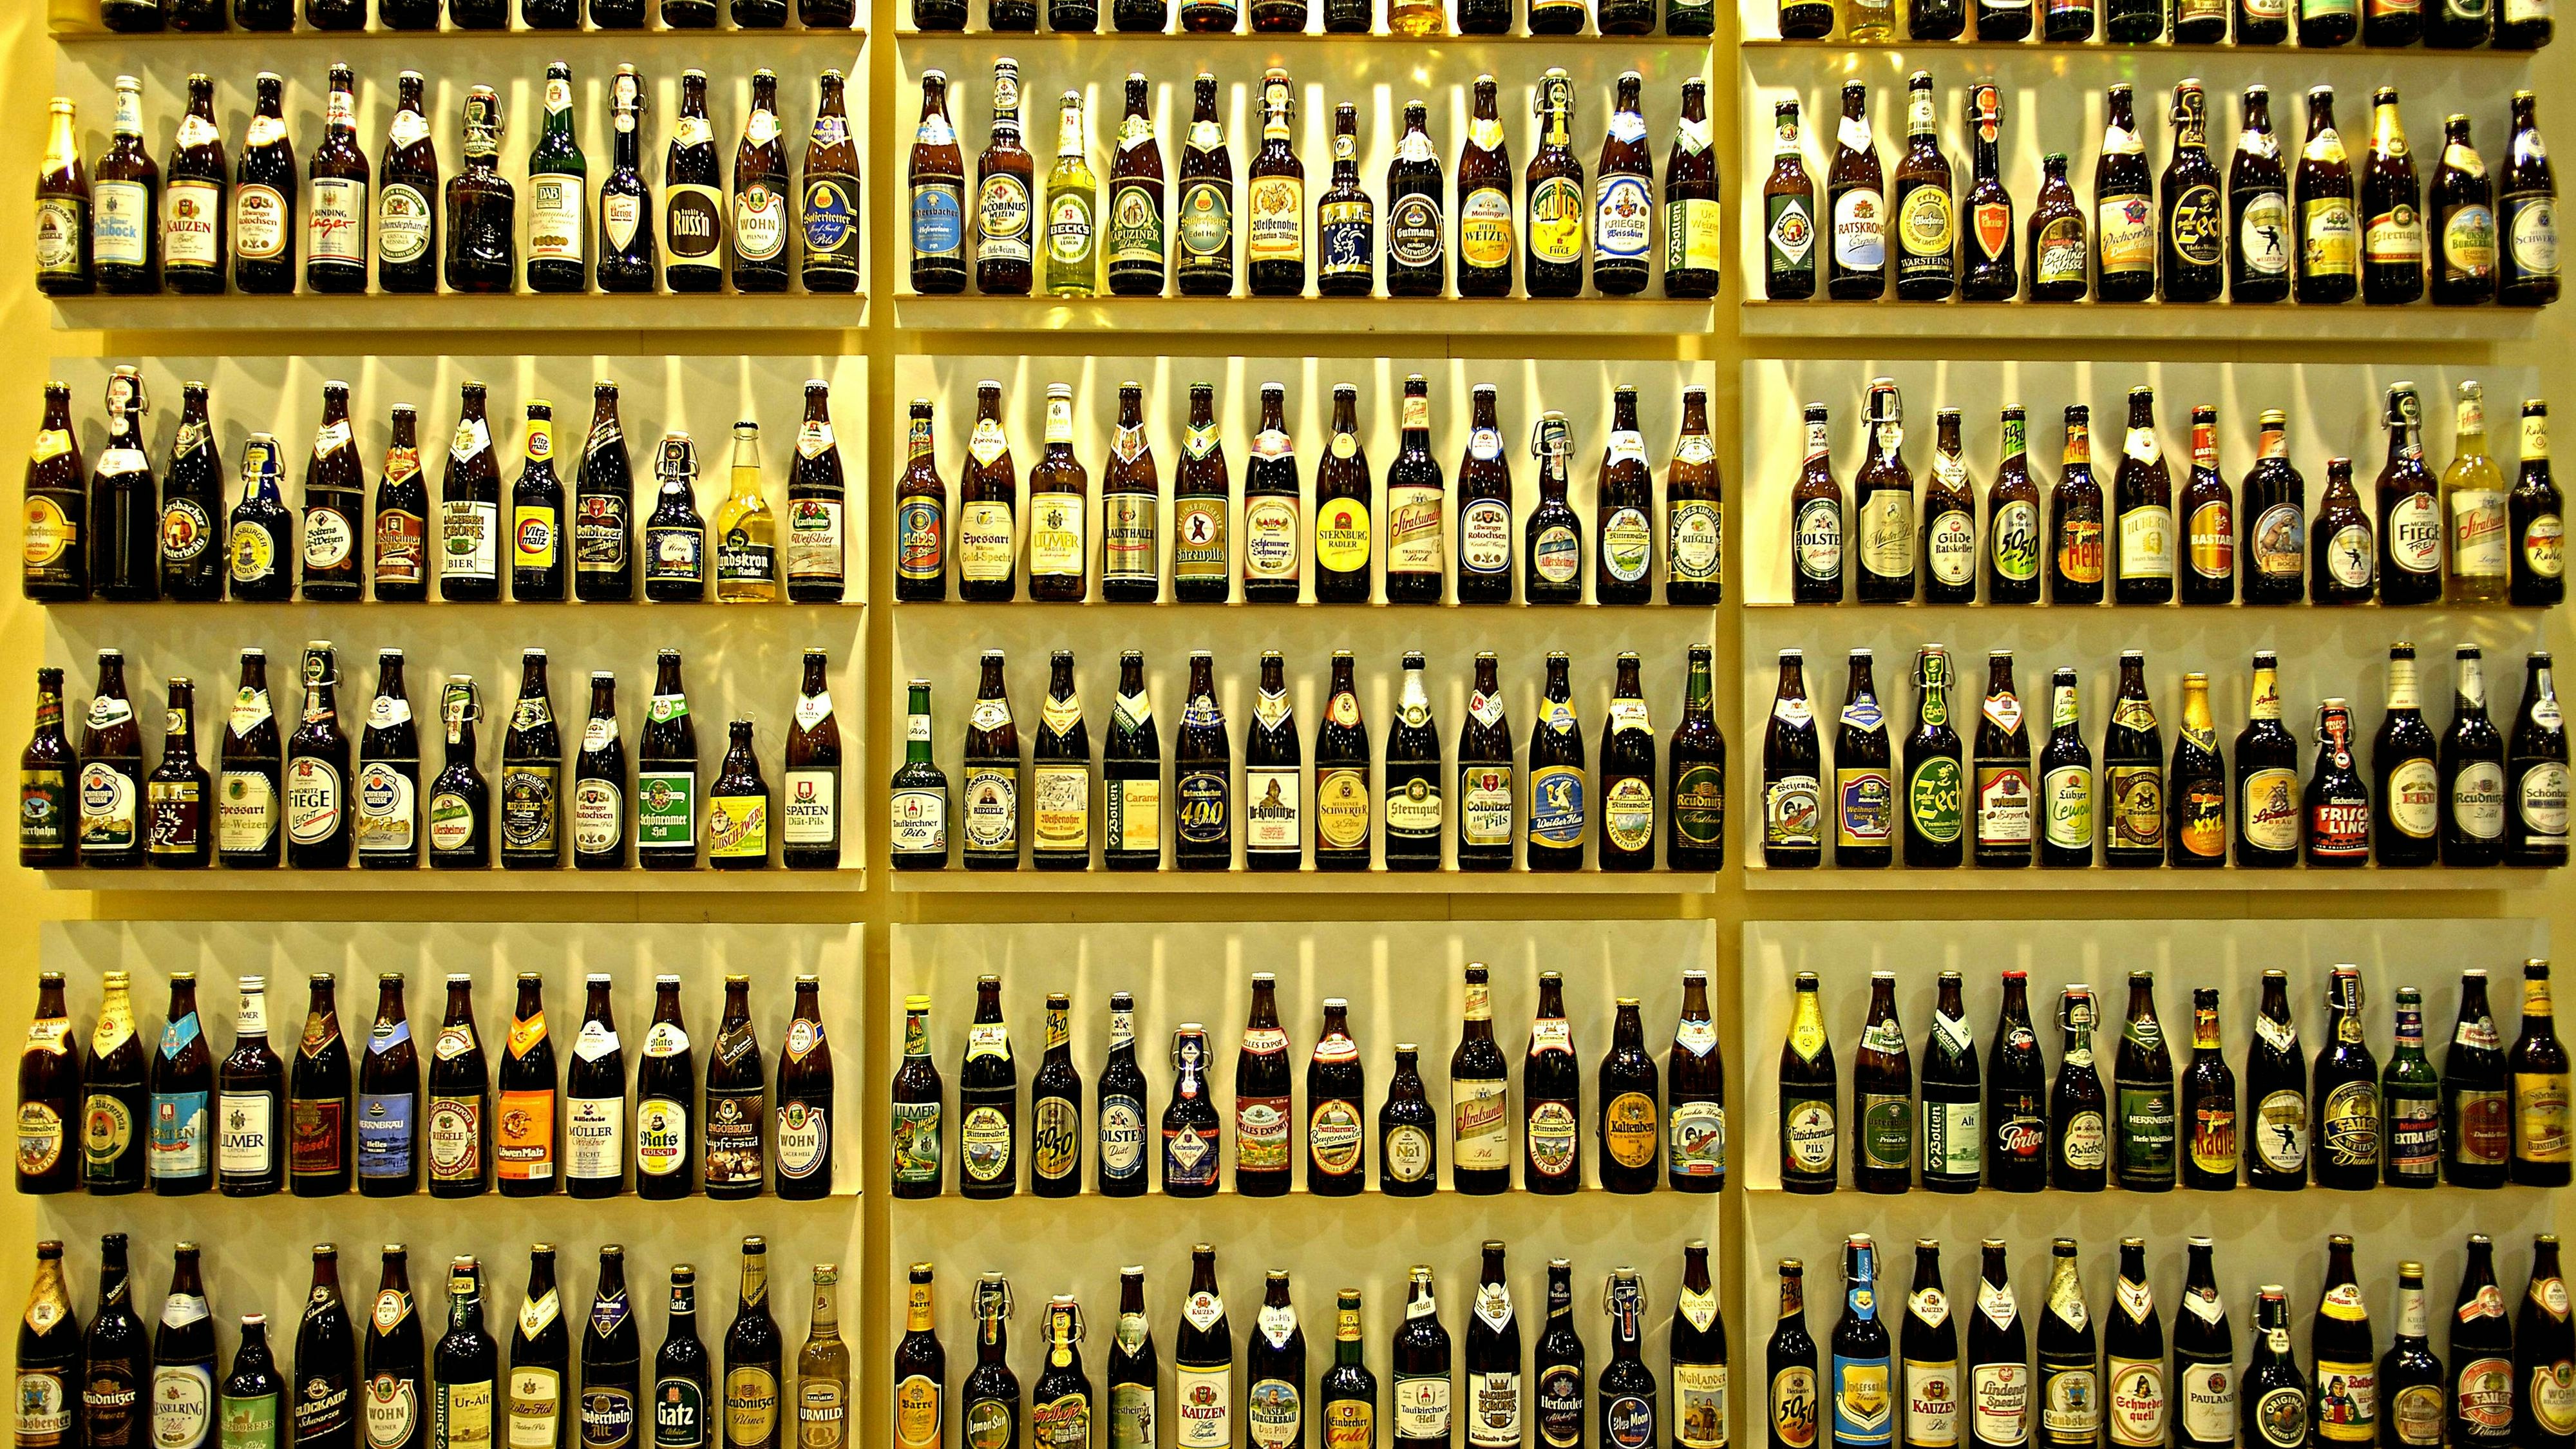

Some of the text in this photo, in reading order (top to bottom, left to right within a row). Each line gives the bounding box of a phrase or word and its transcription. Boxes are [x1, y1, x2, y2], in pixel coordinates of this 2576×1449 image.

[1471, 209, 1505, 218] Moninger
[167, 221, 211, 234] KAUZEN
[740, 219, 775, 231] WOHN
[1604, 220, 1645, 231] KRIEGER
[522, 535, 547, 545] malz
[963, 532, 1009, 545] Spessart
[1319, 530, 1367, 540] STERNBURG
[1468, 531, 1506, 540] Rotochsen
[1682, 534, 1714, 544] RIEGELE
[1937, 533, 1971, 544] Gilde
[1935, 544, 1973, 554] Ratskeller
[448, 558, 473, 569] BIER
[289, 790, 330, 808] FIEGE
[2059, 789, 2087, 800] Lübzer
[507, 801, 540, 811] RIEGELE
[786, 804, 828, 816] SPATEN
[973, 806, 1004, 815] RIEGELE
[1180, 800, 1224, 826] 400
[1484, 815, 1508, 830] Pils
[895, 1106, 934, 1117] ULMER
[1611, 1120, 1654, 1133] Kaltenberg
[1961, 1115, 1975, 1127] Alt
[569, 1126, 612, 1137] MÜLLER
[1260, 1121, 1287, 1135] EXPORT
[640, 1130, 678, 1146] Rats
[781, 1134, 815, 1147] WOHN
[1473, 1148, 1492, 1159] Pils
[1806, 1144, 1824, 1153] PILS
[455, 1394, 489, 1408] Ur-Alt
[902, 1399, 933, 1408] Barre
[1540, 1395, 1582, 1410] Herforder
[1912, 1399, 1956, 1414] KAUZEN
[368, 1407, 404, 1419] WOHN
[658, 1402, 694, 1426] Gatz
[1181, 1405, 1226, 1419] KAUZEN
[1261, 1406, 1285, 1416] UNSER
[970, 1414, 1006, 1433] Lemon Sun
[1613, 1413, 1648, 1431] Blue Moon
[1327, 1428, 1365, 1442] Gold
